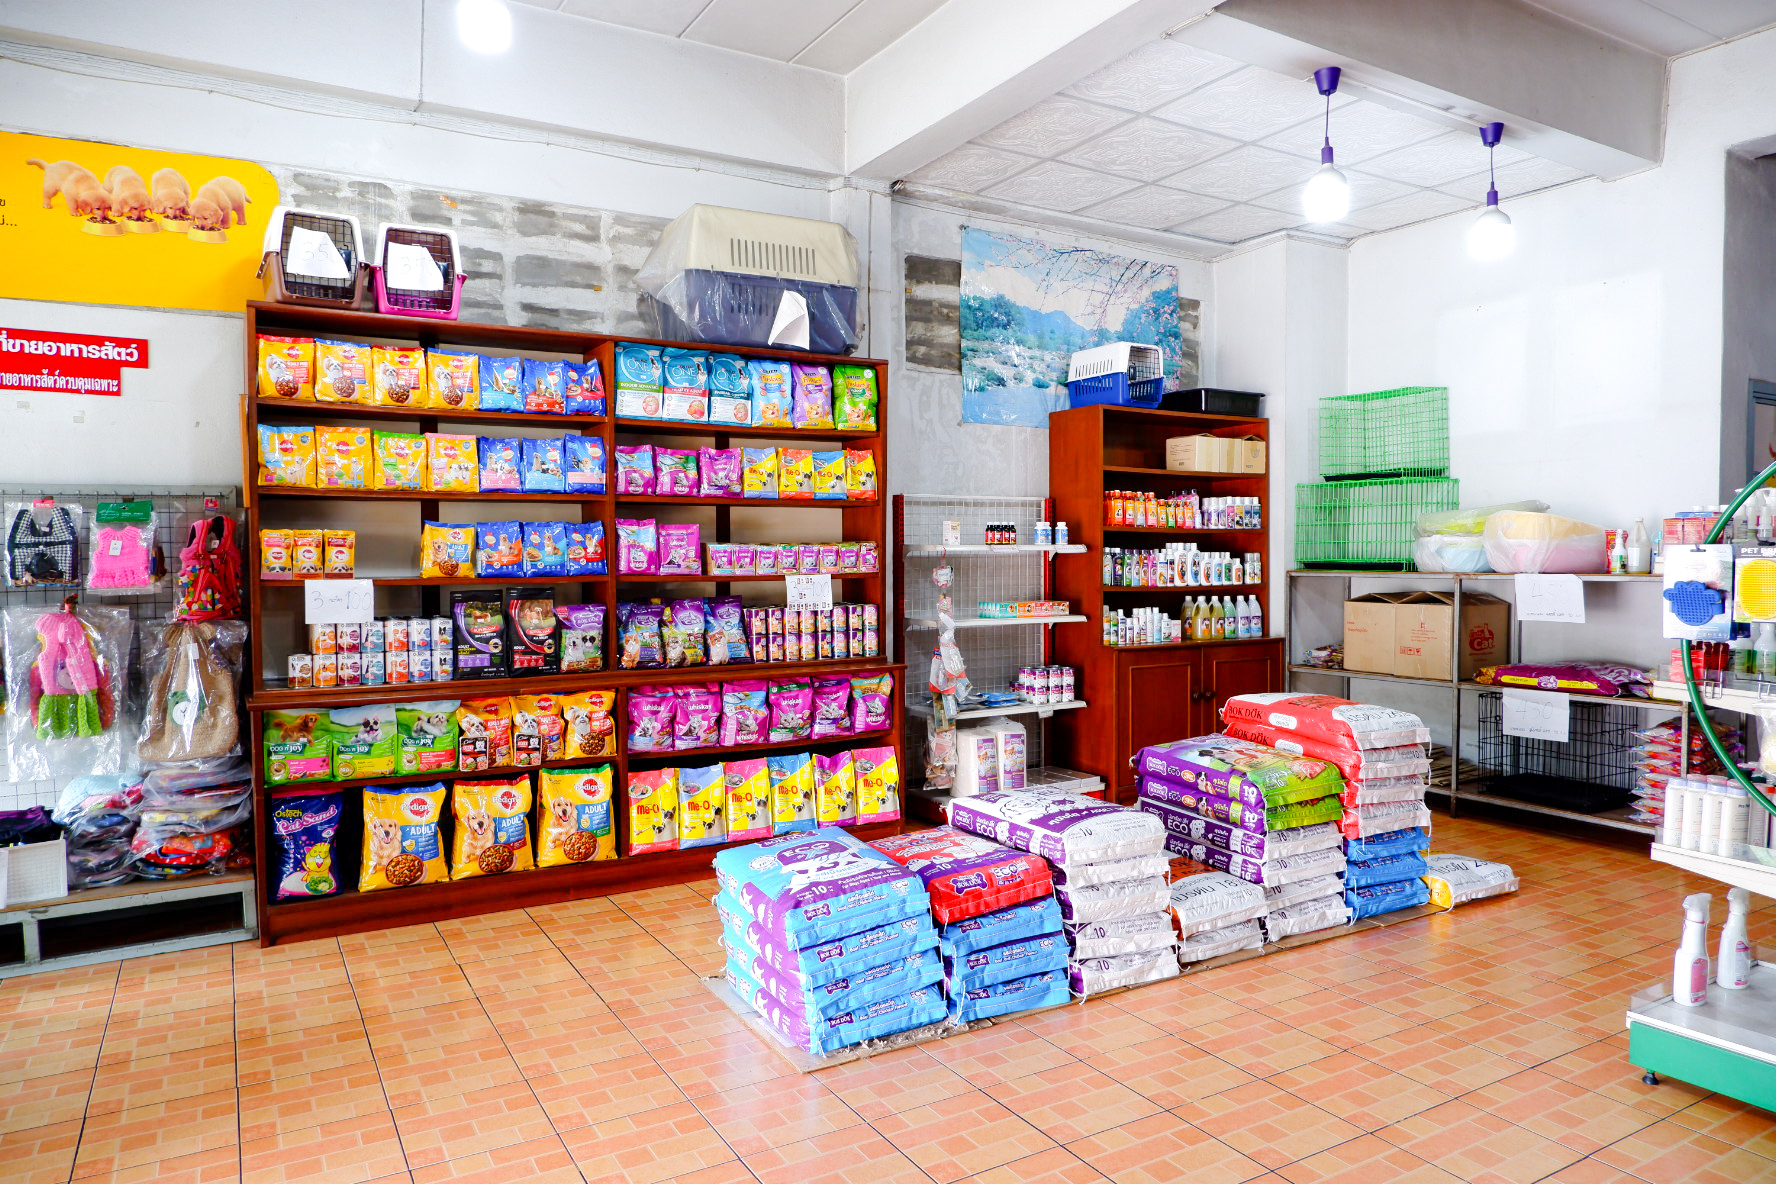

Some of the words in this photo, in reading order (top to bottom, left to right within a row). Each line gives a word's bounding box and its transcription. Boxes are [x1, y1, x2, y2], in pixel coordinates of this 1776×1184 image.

[628, 358, 649, 371] ONE
[672, 367, 695, 377] ONE
[717, 370, 736, 382] ONE
[311, 590, 324, 610] 3
[346, 590, 372, 611] 100
[1474, 639, 1493, 650] Cat
[643, 703, 664, 711] whiskas
[688, 703, 712, 711] whiskas
[420, 736, 433, 747] joy
[289, 743, 303, 753] joy
[357, 744, 370, 754] joy
[863, 778, 883, 788] Me-O
[778, 785, 798, 795] Me-O
[1243, 785, 1257, 797] 10
[731, 792, 753, 803] Me-O
[585, 803, 607, 814] ADULT
[637, 804, 660, 815] Me-O
[688, 800, 710, 811] Me-O
[277, 818, 304, 834] Cat
[303, 804, 337, 823] Sand
[501, 815, 525, 828] ADULT
[1244, 811, 1258, 823] 10
[410, 824, 435, 836] ADULT
[976, 822, 994, 838] ECO
[1080, 827, 1093, 836] 10
[1167, 820, 1189, 834] ECO
[1278, 832, 1287, 841] 10
[782, 842, 830, 858] ECO
[1242, 845, 1251, 853] 10
[938, 862, 951, 871] 10
[1277, 859, 1288, 869] 10
[993, 864, 1018, 879] ECO
[811, 885, 828, 895] 10
[1273, 885, 1281, 894] 10
[1094, 926, 1106, 938] 10
[1097, 960, 1110, 970] 10
